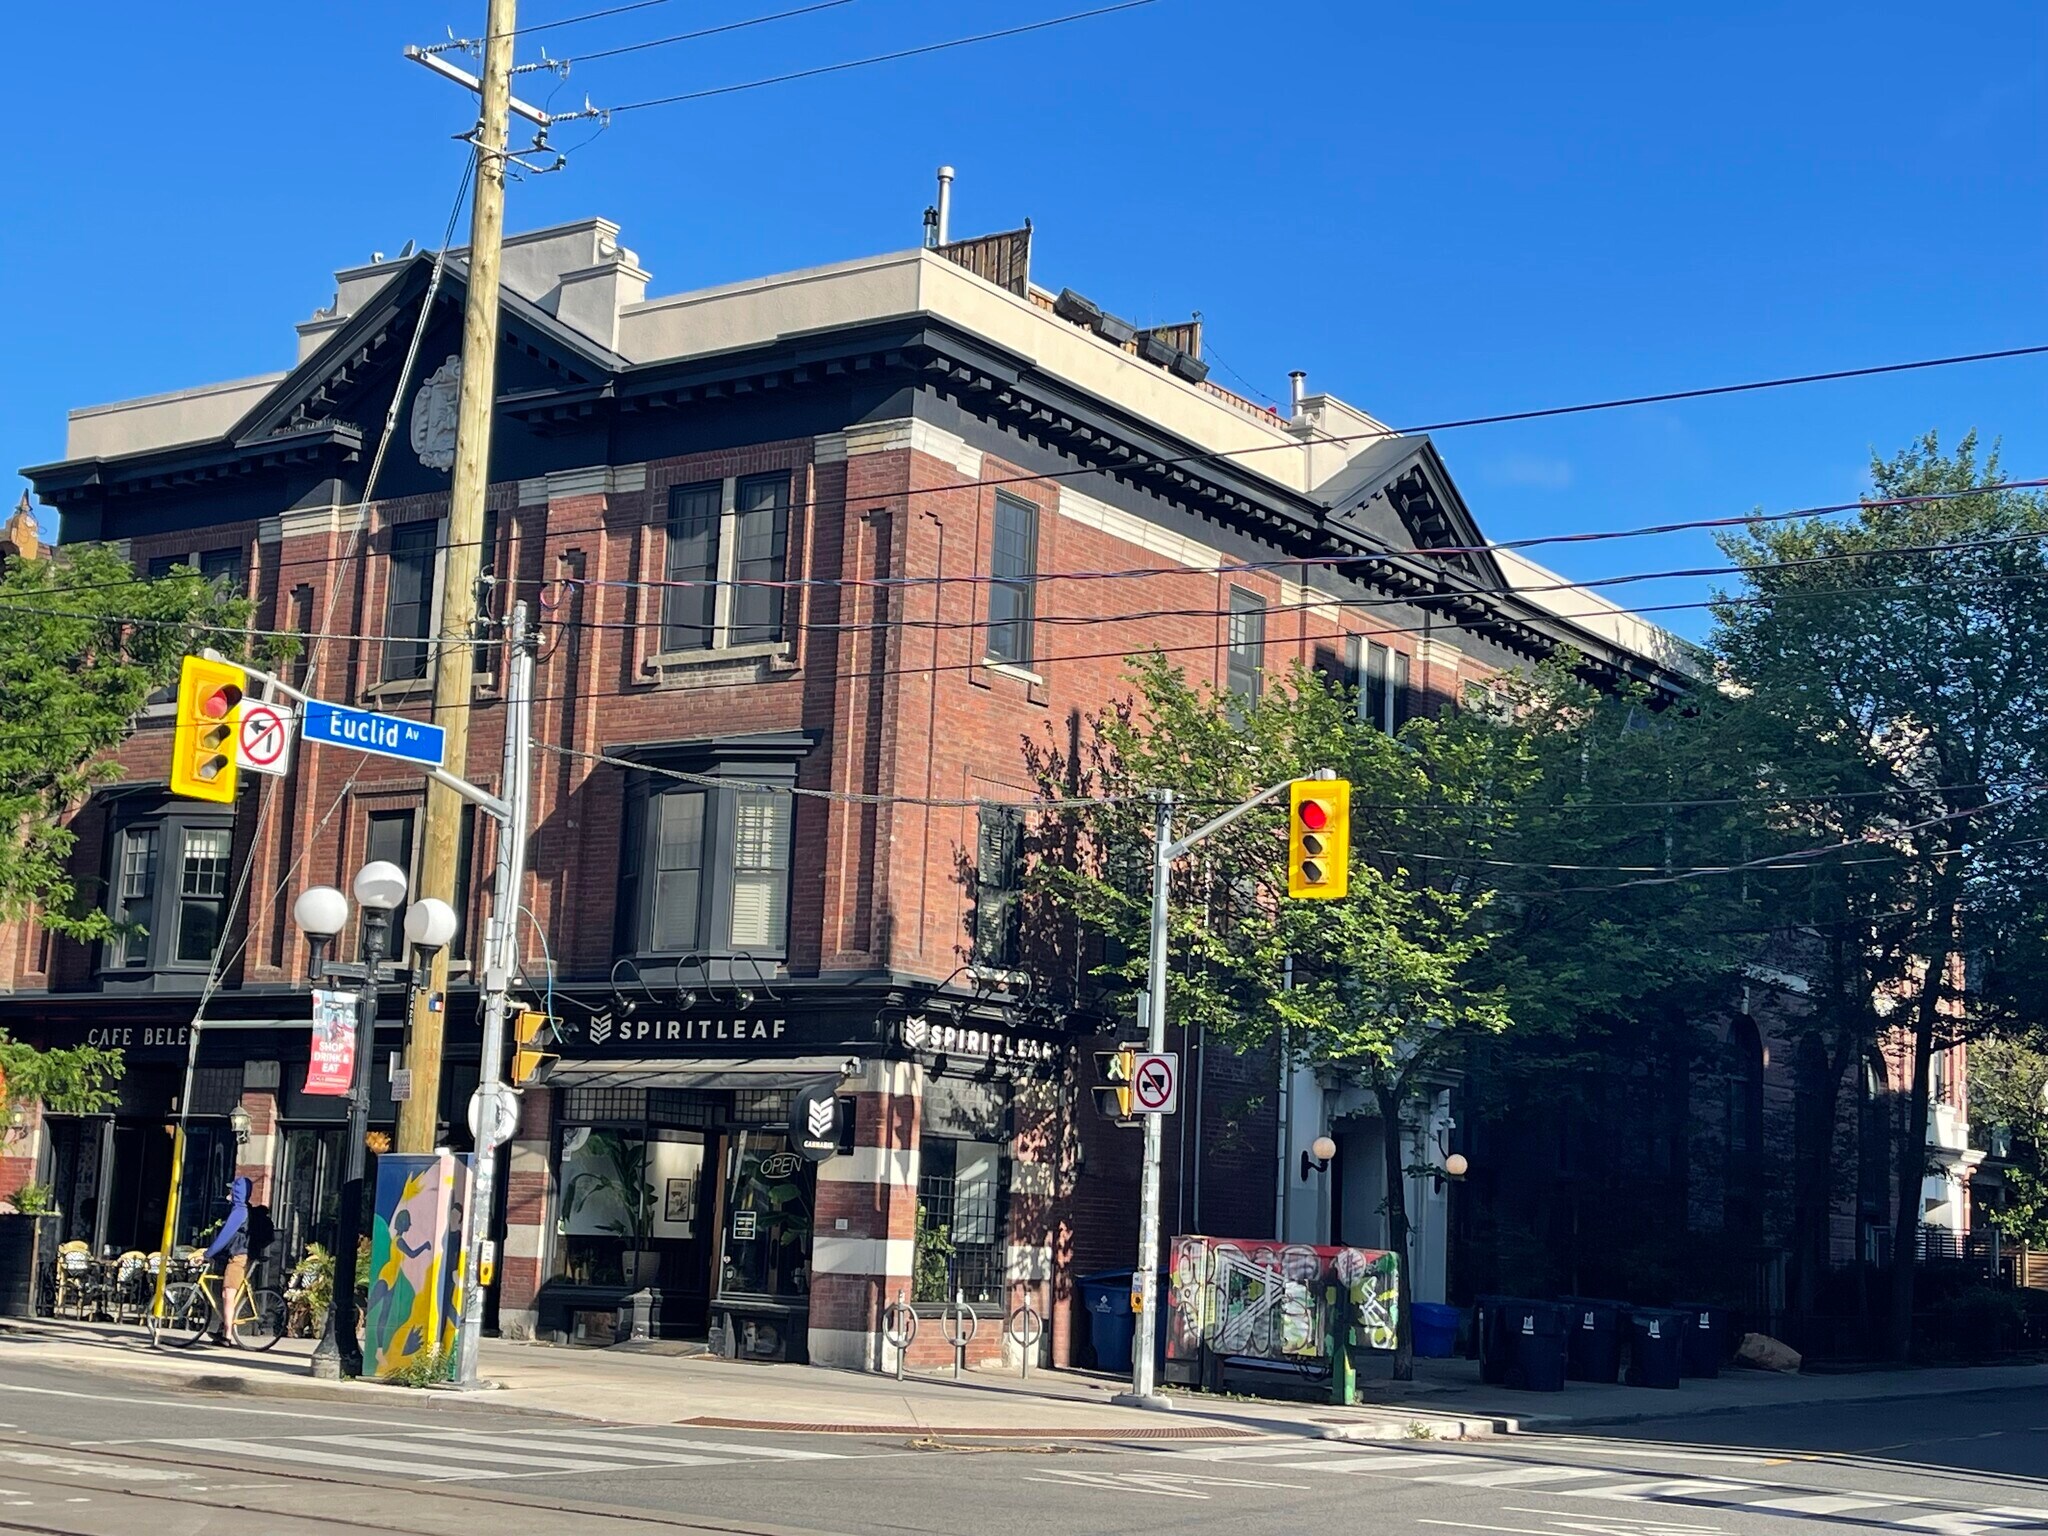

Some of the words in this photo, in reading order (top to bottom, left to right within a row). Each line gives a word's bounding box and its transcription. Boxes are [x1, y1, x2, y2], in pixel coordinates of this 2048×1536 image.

[330, 710, 398, 748] Euclid
[405, 726, 420, 741] Av
[619, 1019, 786, 1040] SPIRITLEAF
[87, 1028, 133, 1046] CAFE
[319, 1041, 345, 1052] SHOP
[314, 1052, 341, 1063] DRINK
[342, 1054, 350, 1064] &
[322, 1062, 340, 1073] EAT
[804, 1140, 834, 1149] CANNABIS
[760, 1157, 801, 1174] OPEN
